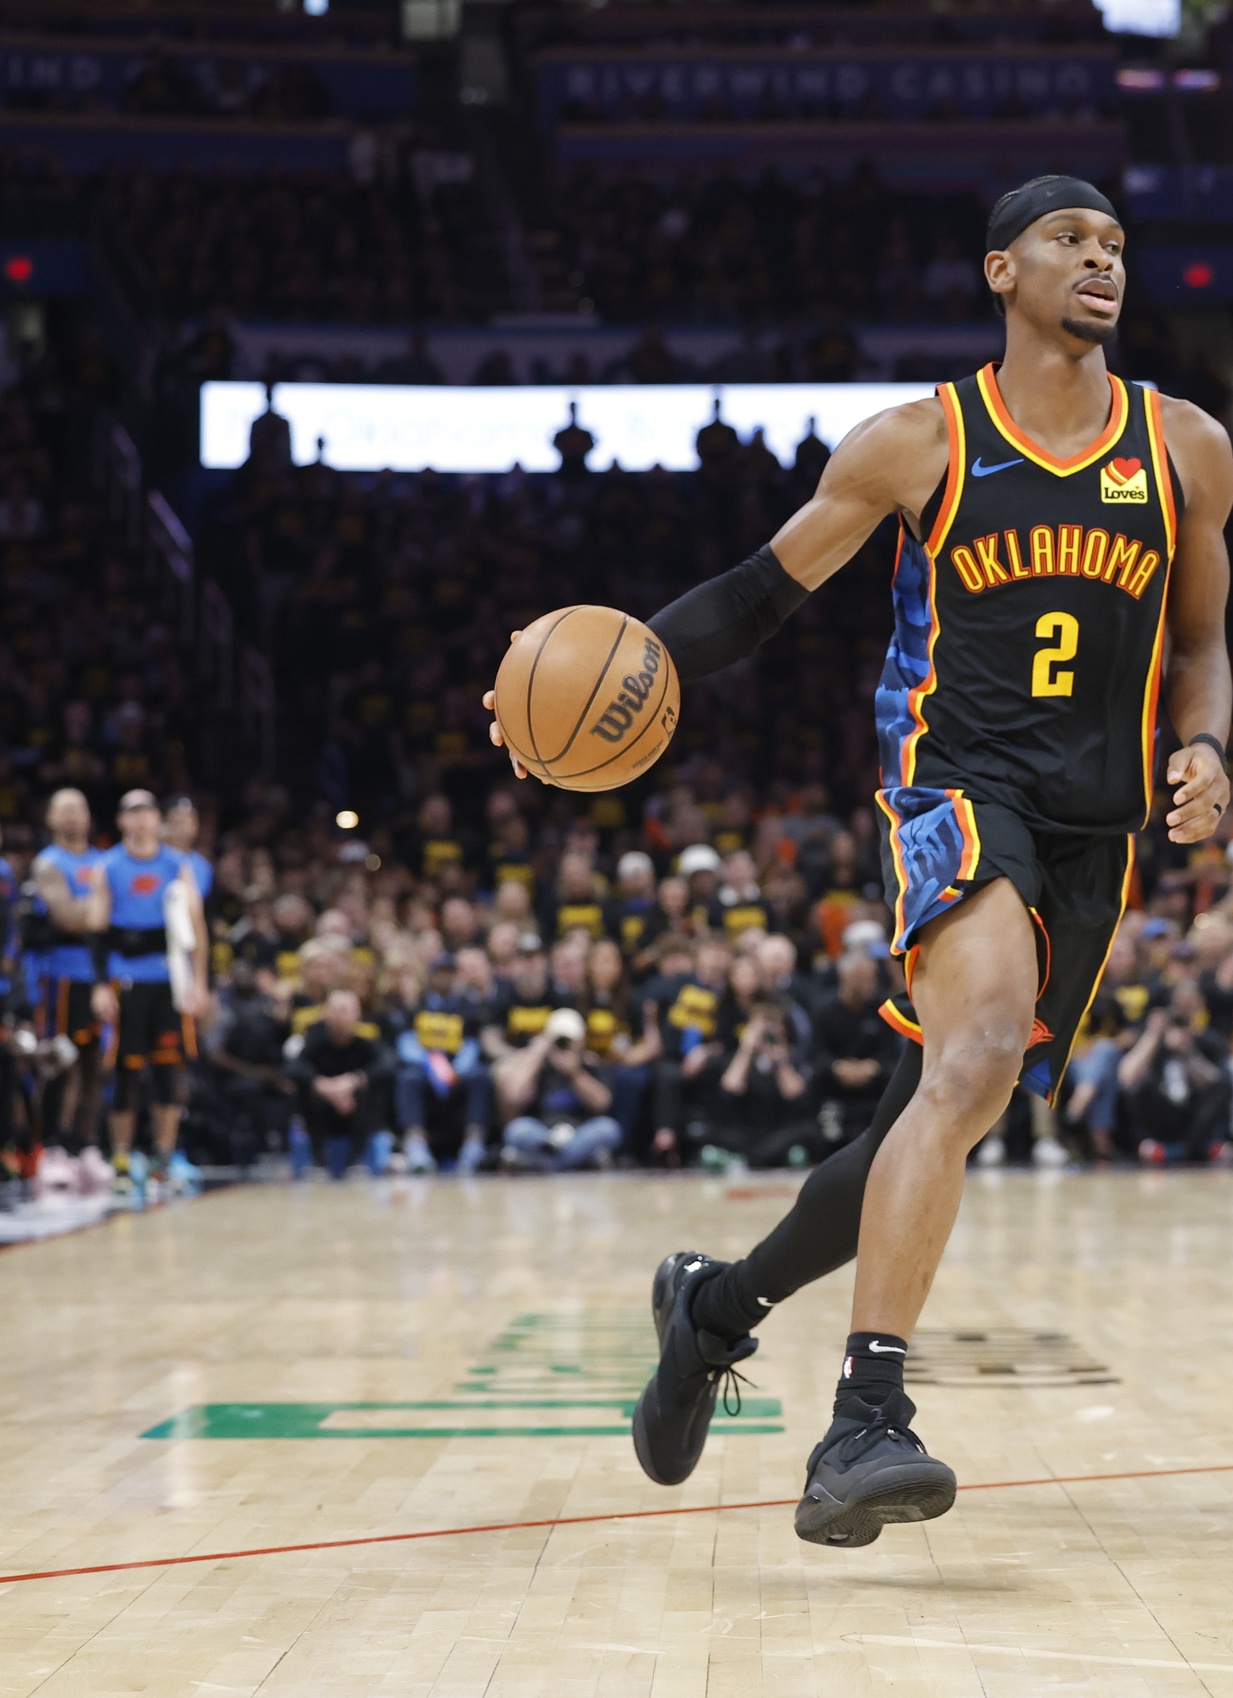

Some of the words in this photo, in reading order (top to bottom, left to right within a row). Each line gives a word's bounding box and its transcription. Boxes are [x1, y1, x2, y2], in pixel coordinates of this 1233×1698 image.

[567, 64, 868, 97] RIVERWIND
[892, 63, 1090, 96] CASINO
[951, 524, 1160, 600] OKLAHOMA
[589, 637, 661, 743] Wilson
[1032, 611, 1079, 697] 2
